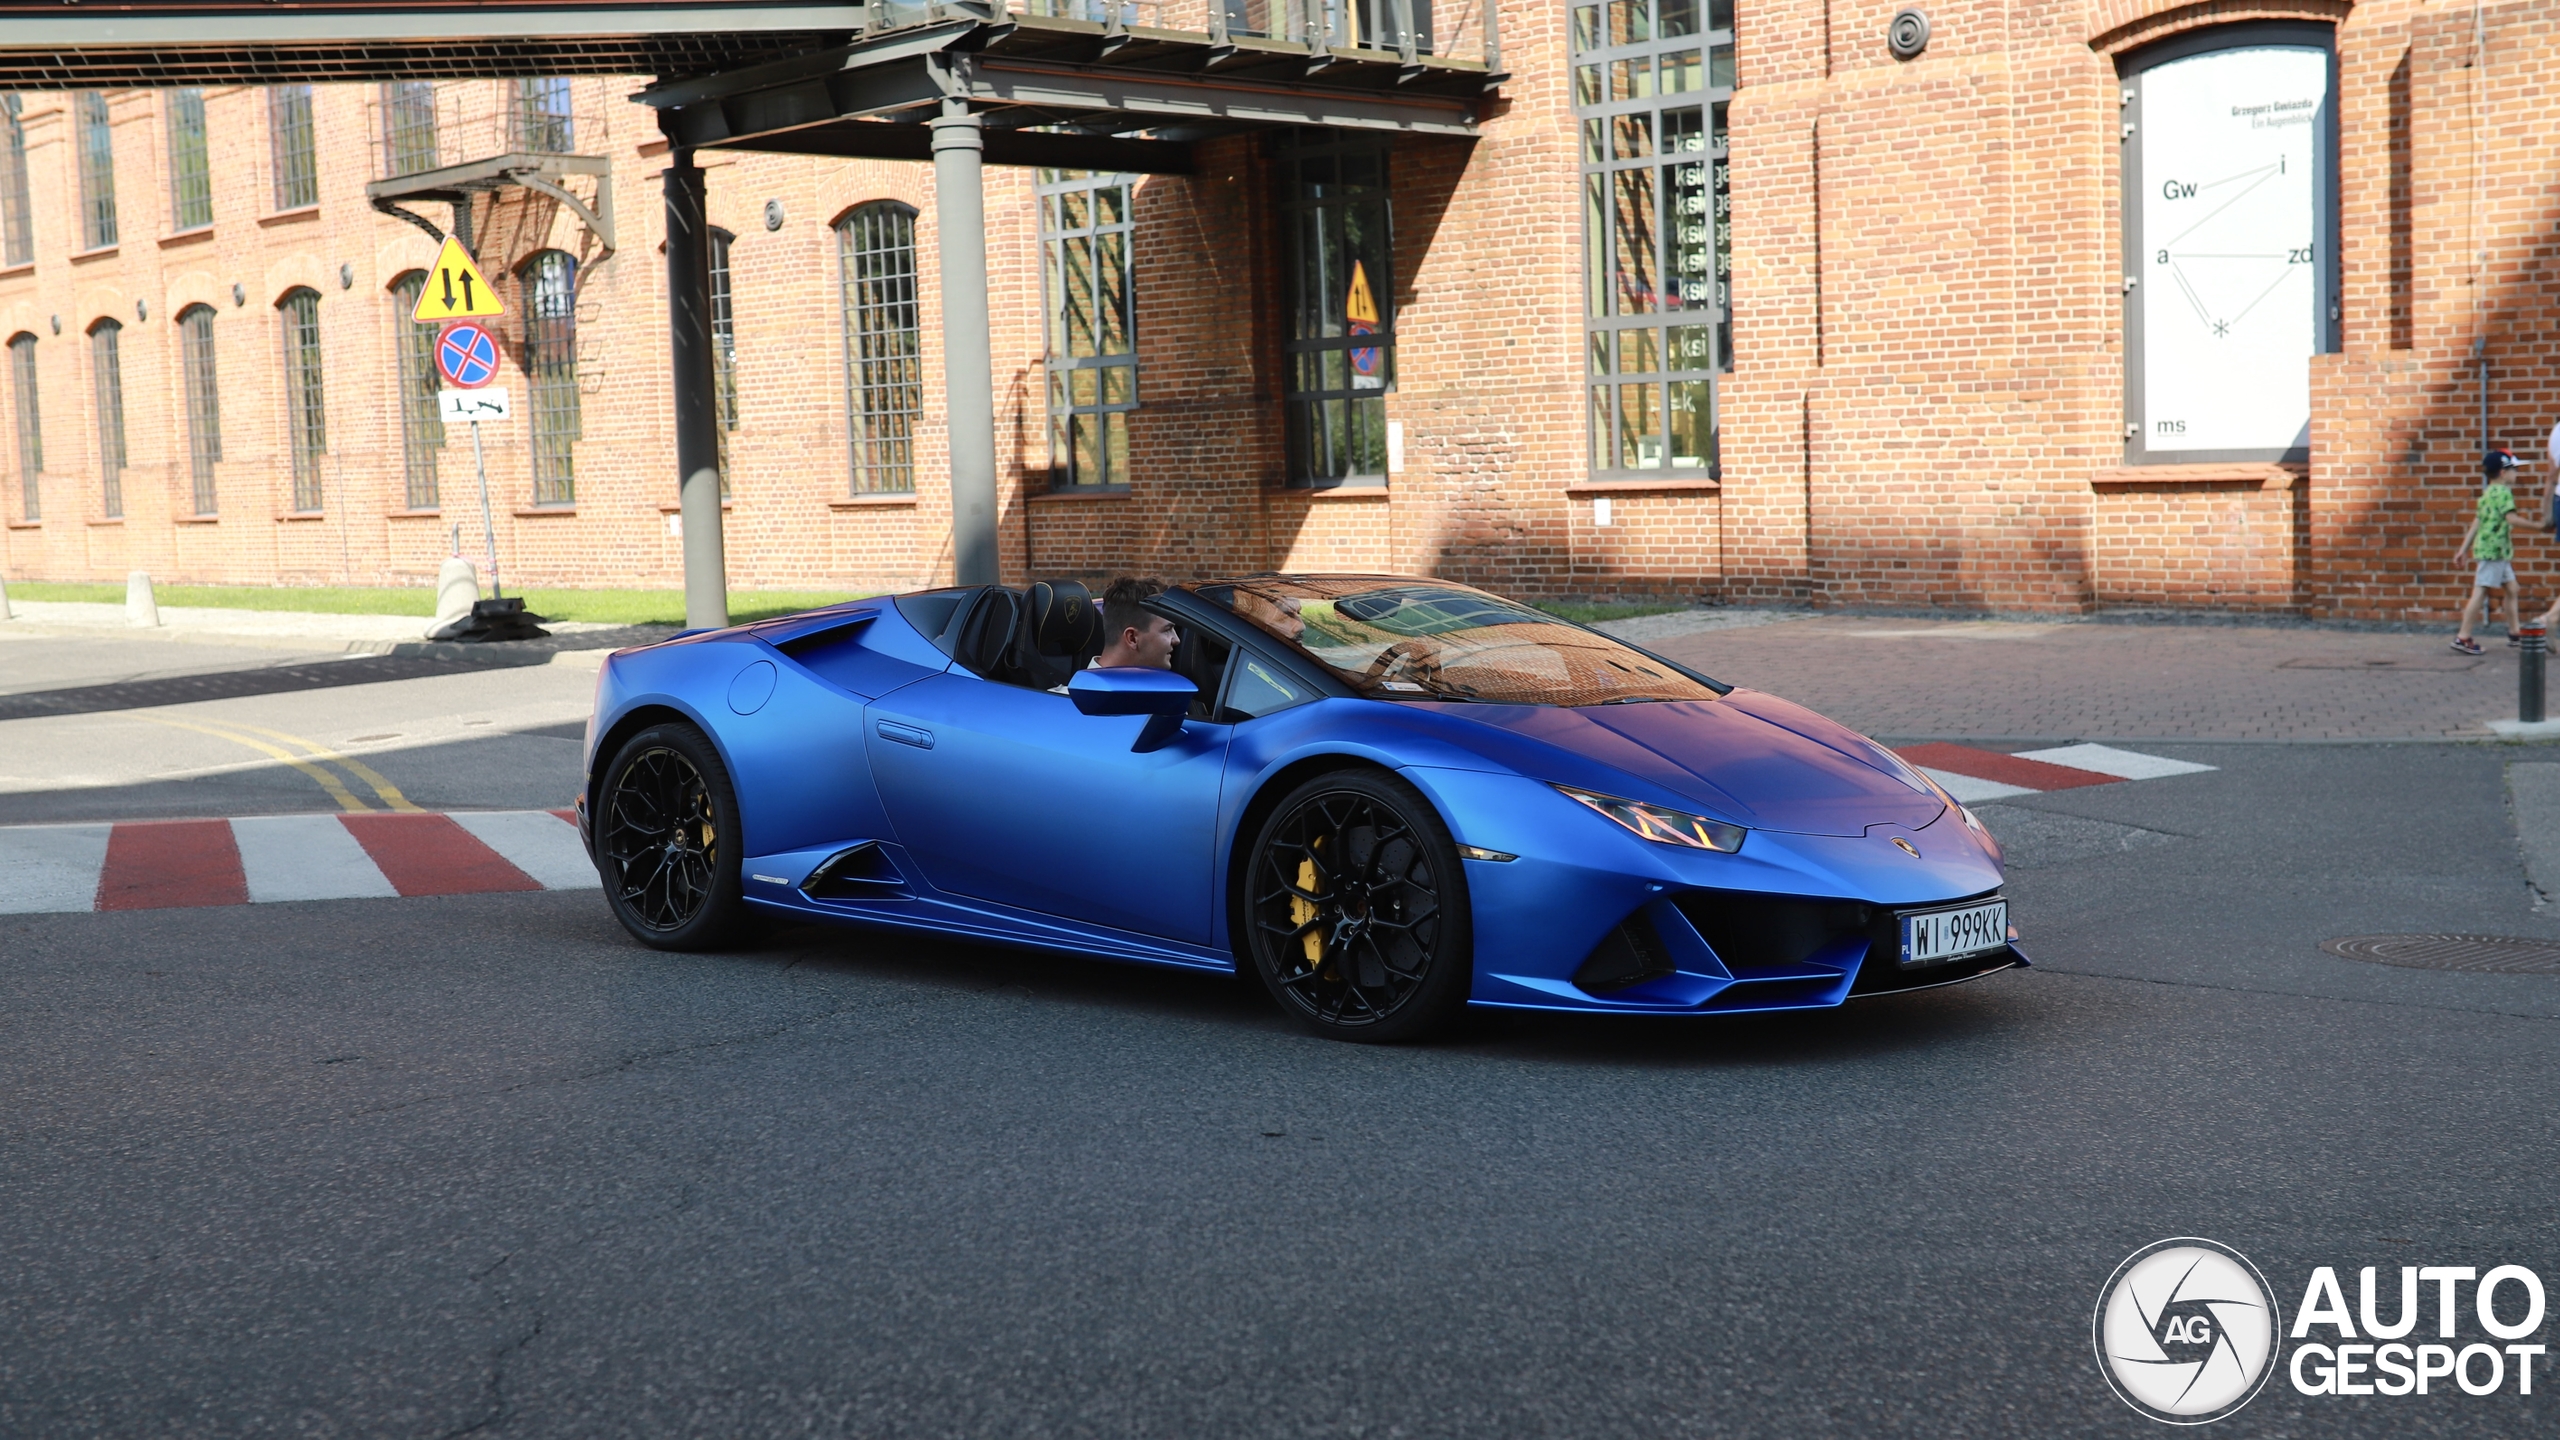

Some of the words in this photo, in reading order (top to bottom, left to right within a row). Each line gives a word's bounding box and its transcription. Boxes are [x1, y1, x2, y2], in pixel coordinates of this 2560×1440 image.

[2232, 104, 2271, 117] Grzegorz
[2274, 99, 2313, 112] Gwiazda
[2163, 180, 2197, 200] Gw
[2157, 249, 2169, 264] a
[2288, 243, 2313, 264] zd
[2158, 420, 2186, 432] ms
[1902, 945, 1910, 955] PL
[1916, 918, 1938, 956] WI
[1951, 906, 2002, 950] 999KK
